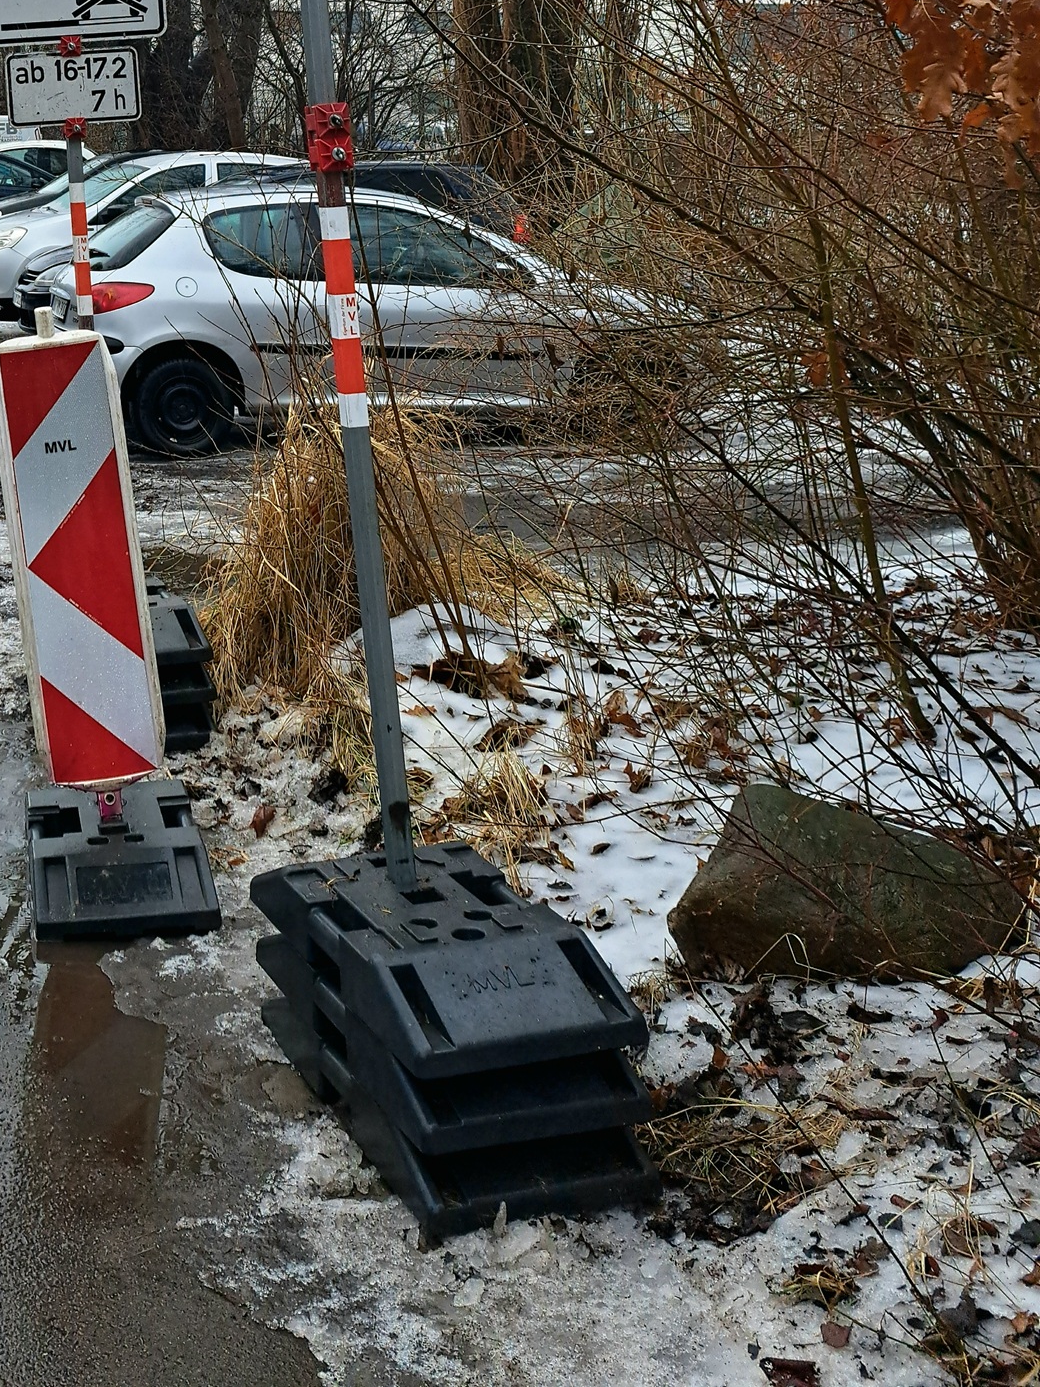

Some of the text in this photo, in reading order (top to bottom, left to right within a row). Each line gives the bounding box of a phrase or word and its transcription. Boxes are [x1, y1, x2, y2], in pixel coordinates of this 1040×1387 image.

[15, 57, 127, 84] ab 16-17.2
[92, 88, 126, 112] 7 h
[44, 440, 77, 454] MVL
[467, 965, 535, 993] MVL
